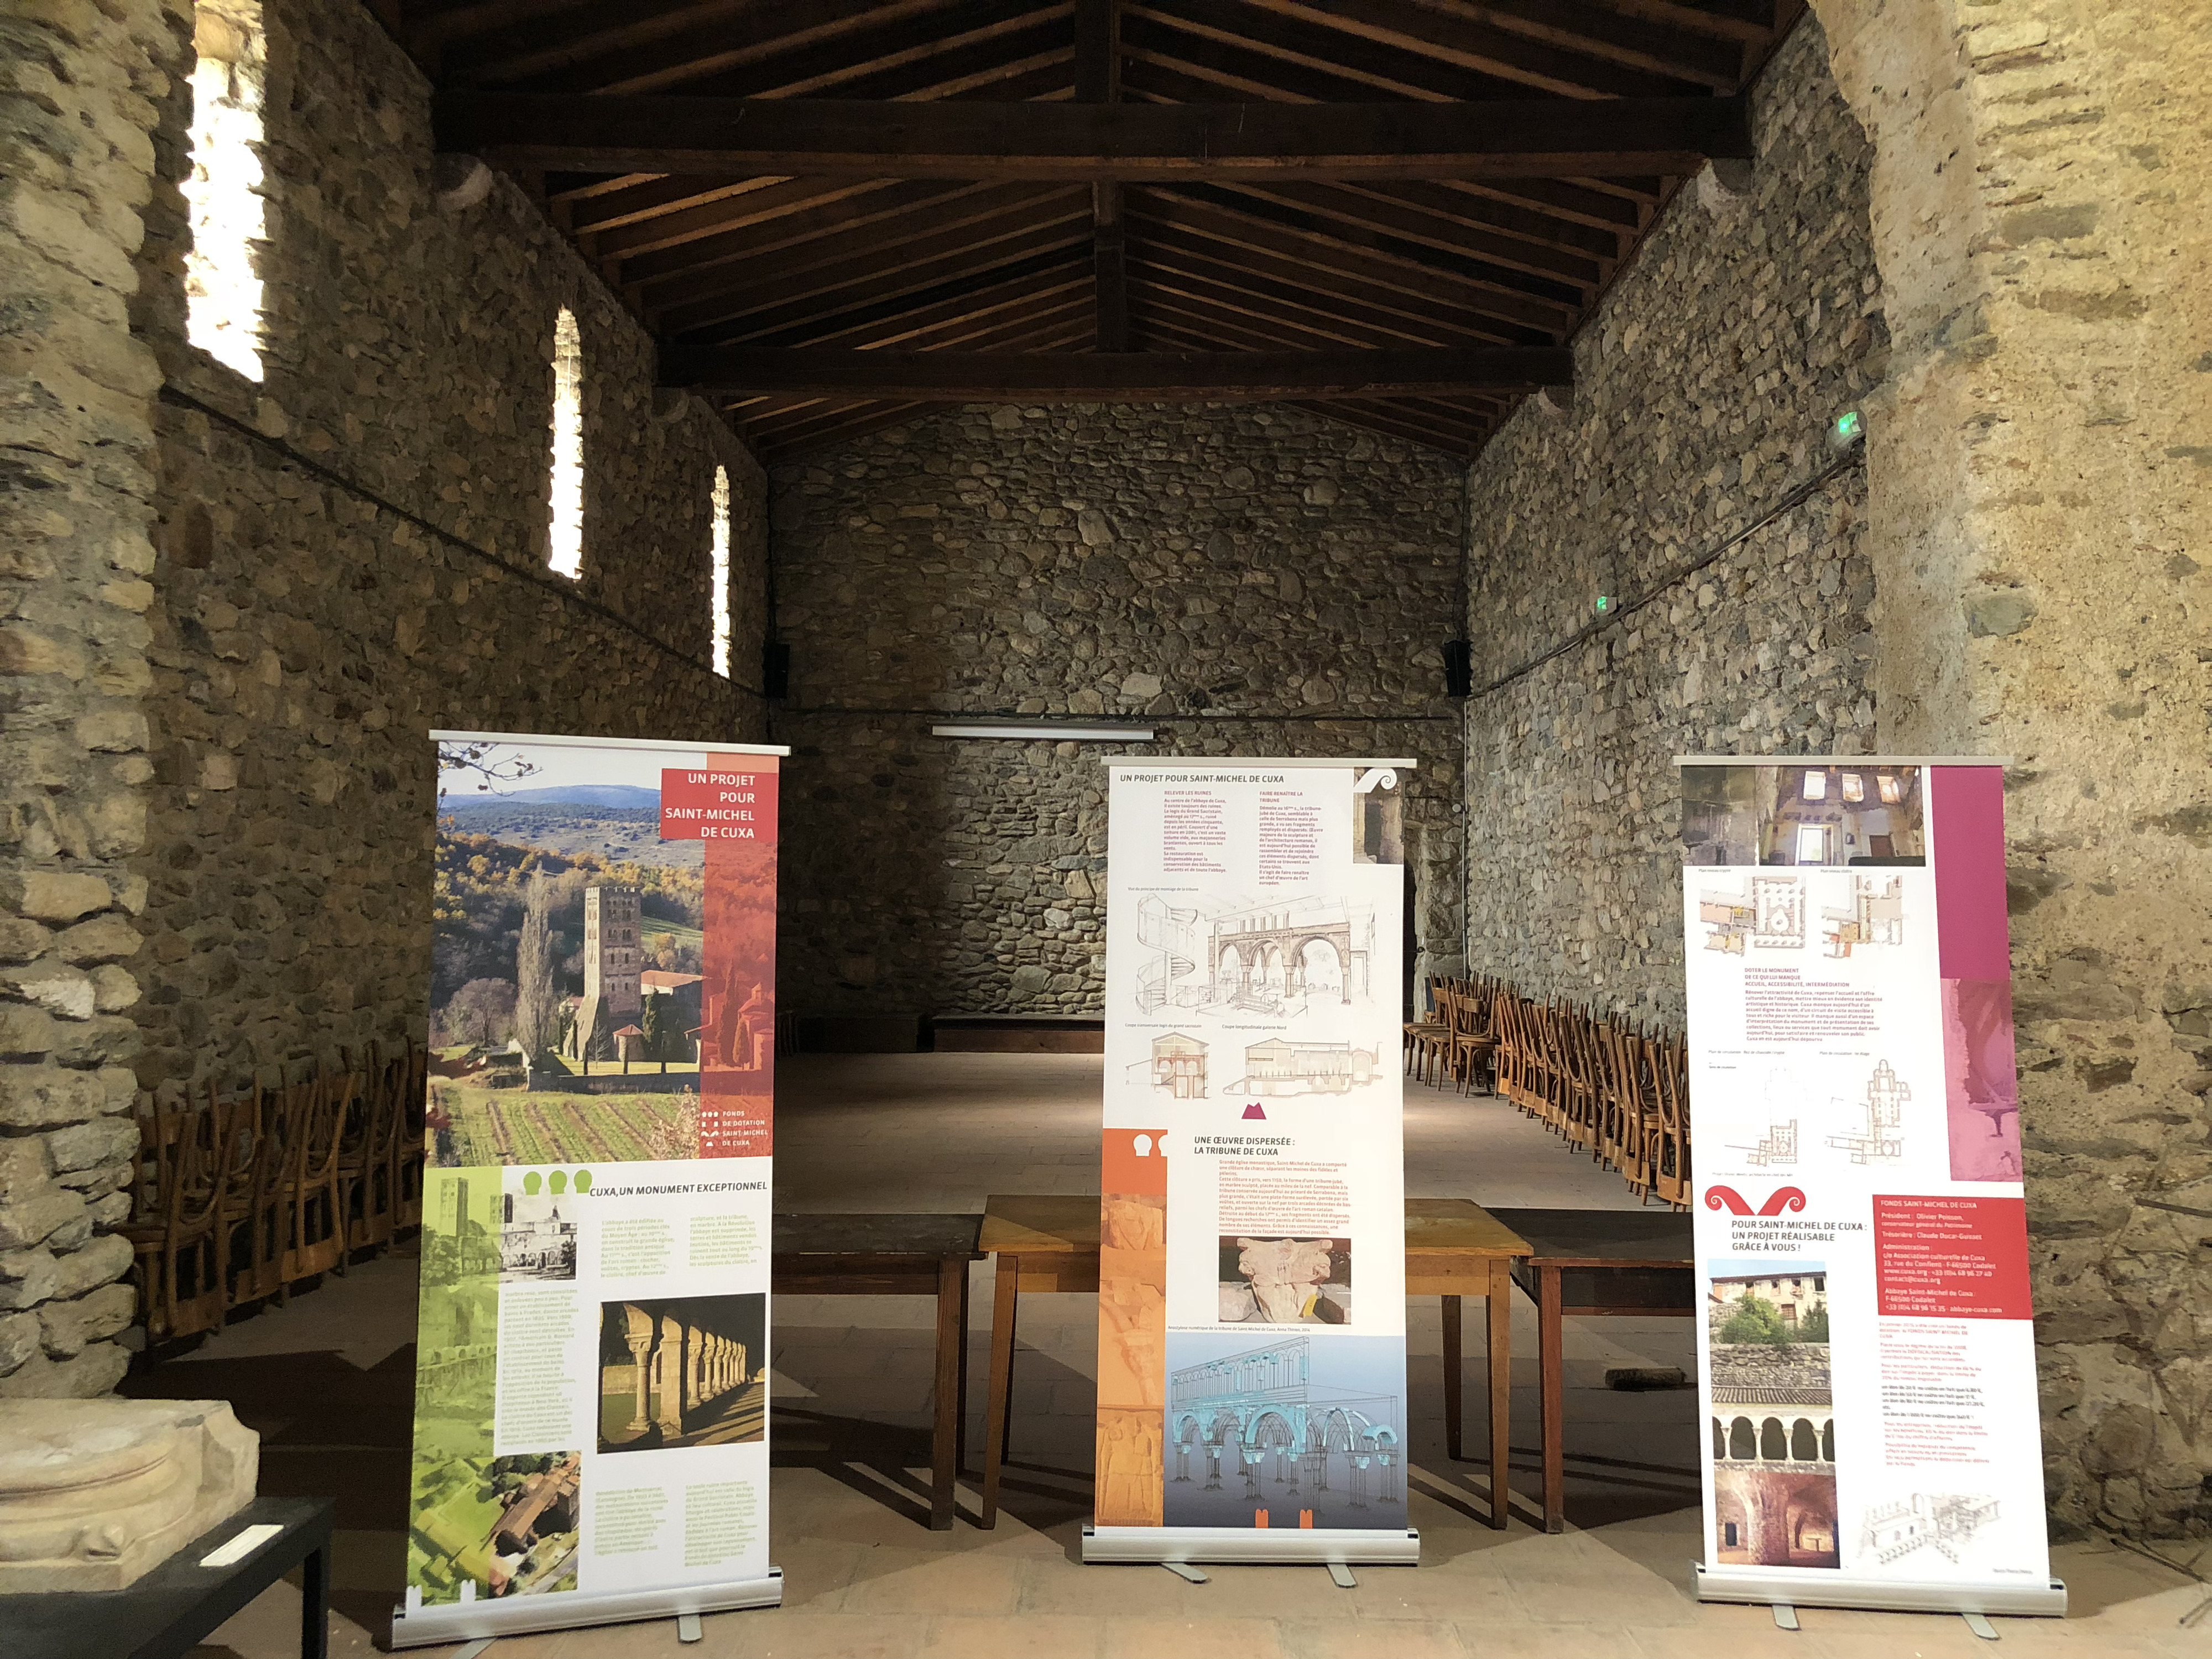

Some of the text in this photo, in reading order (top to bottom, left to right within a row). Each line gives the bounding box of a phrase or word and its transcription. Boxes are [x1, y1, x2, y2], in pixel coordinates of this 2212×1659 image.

[688, 773, 755, 787] UN PROJET
[1134, 775, 1164, 783] PROJET
[720, 792, 755, 803] POUR
[666, 808, 754, 821] SAINT-MICHEL
[701, 827, 754, 838] DE CUXA
[1246, 1137, 1291, 1145] DISPERSÉE
[636, 1185, 695, 1194] MONUMENT
[697, 1182, 767, 1192] EXCEPTIONNEL
[1759, 1221, 1821, 1229] SAINT-MICHEL
[1747, 1232, 1778, 1240] PROJET
[1781, 1232, 1835, 1241] RÉALISABLE
[1732, 1242, 1761, 1250] GRÂCE
